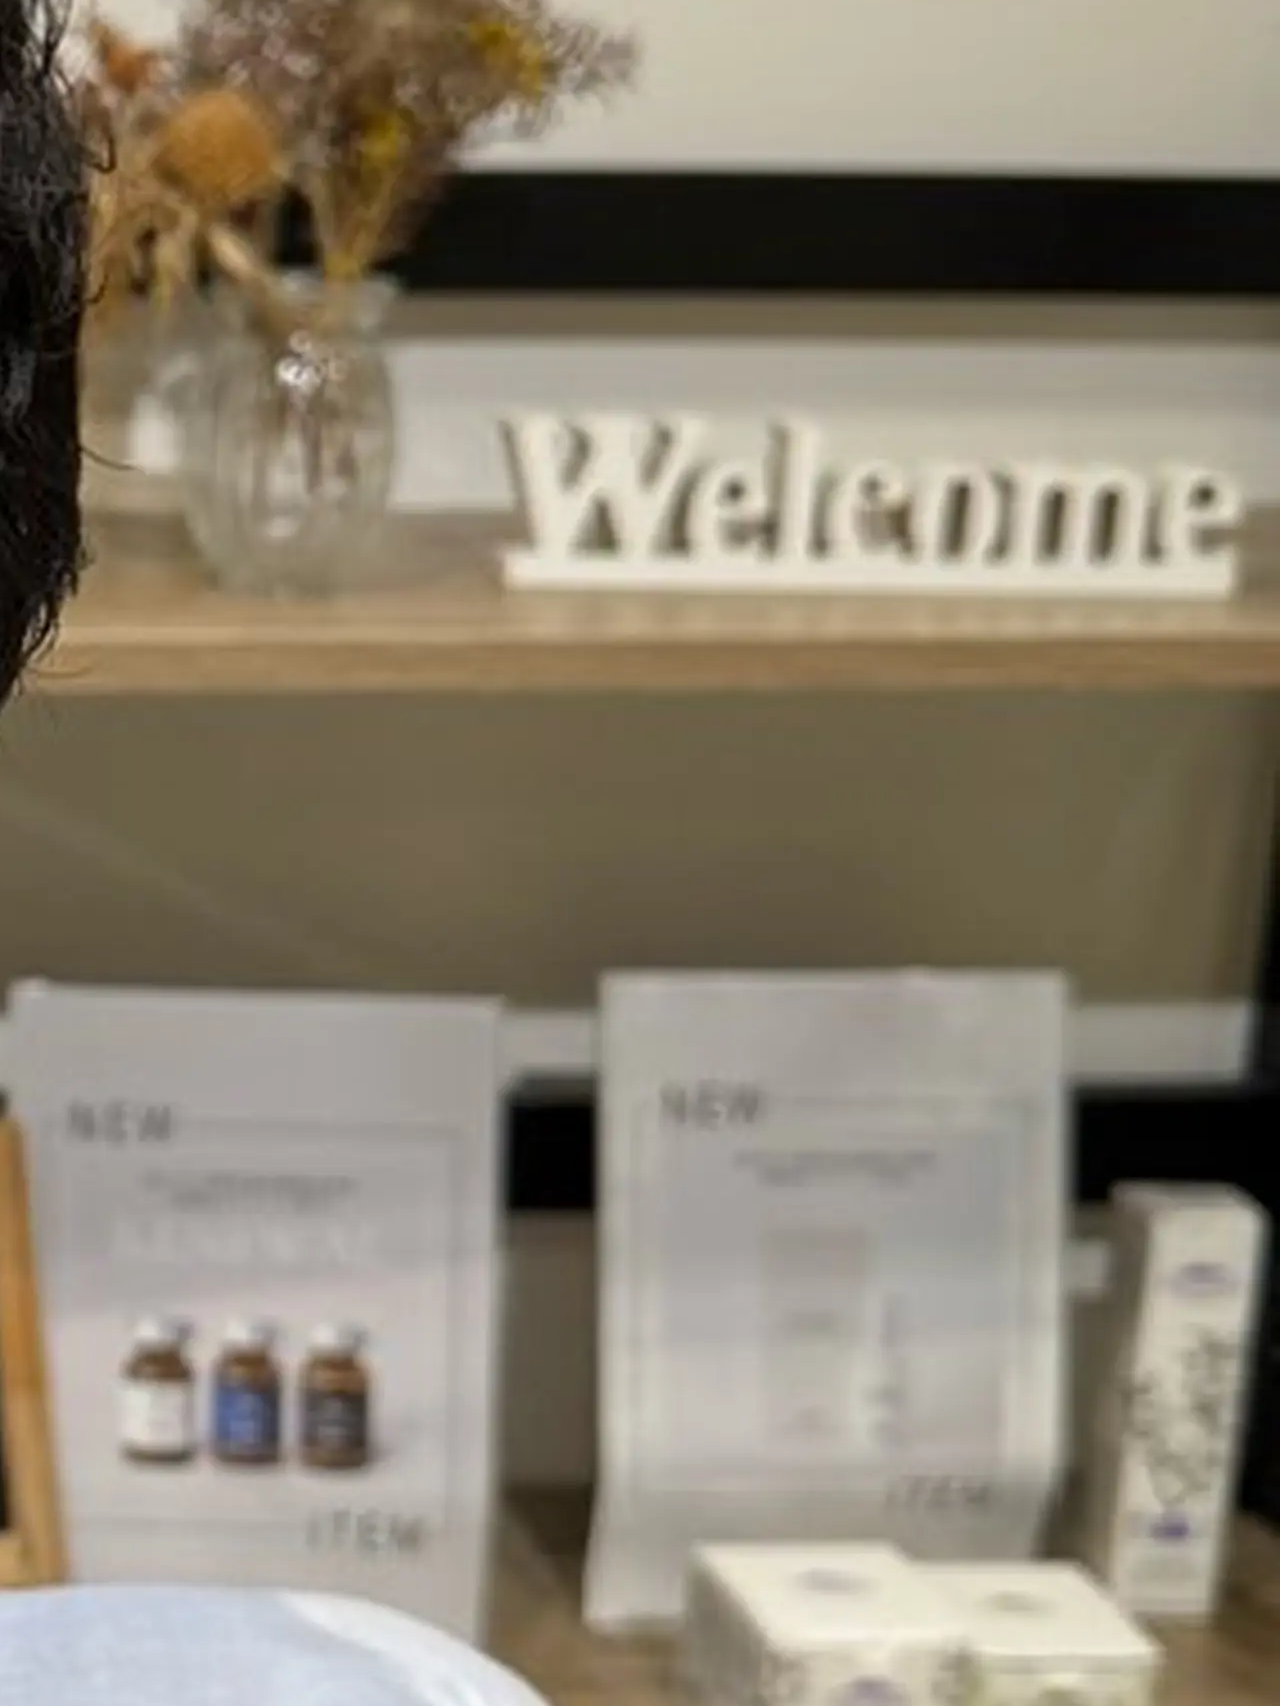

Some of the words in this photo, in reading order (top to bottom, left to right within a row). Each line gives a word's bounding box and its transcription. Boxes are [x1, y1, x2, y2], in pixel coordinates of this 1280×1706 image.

[500, 411, 1244, 565] Welcome
[64, 1099, 175, 1148] NEW
[658, 1079, 762, 1129] NEW
[306, 1507, 424, 1557] ITEM
